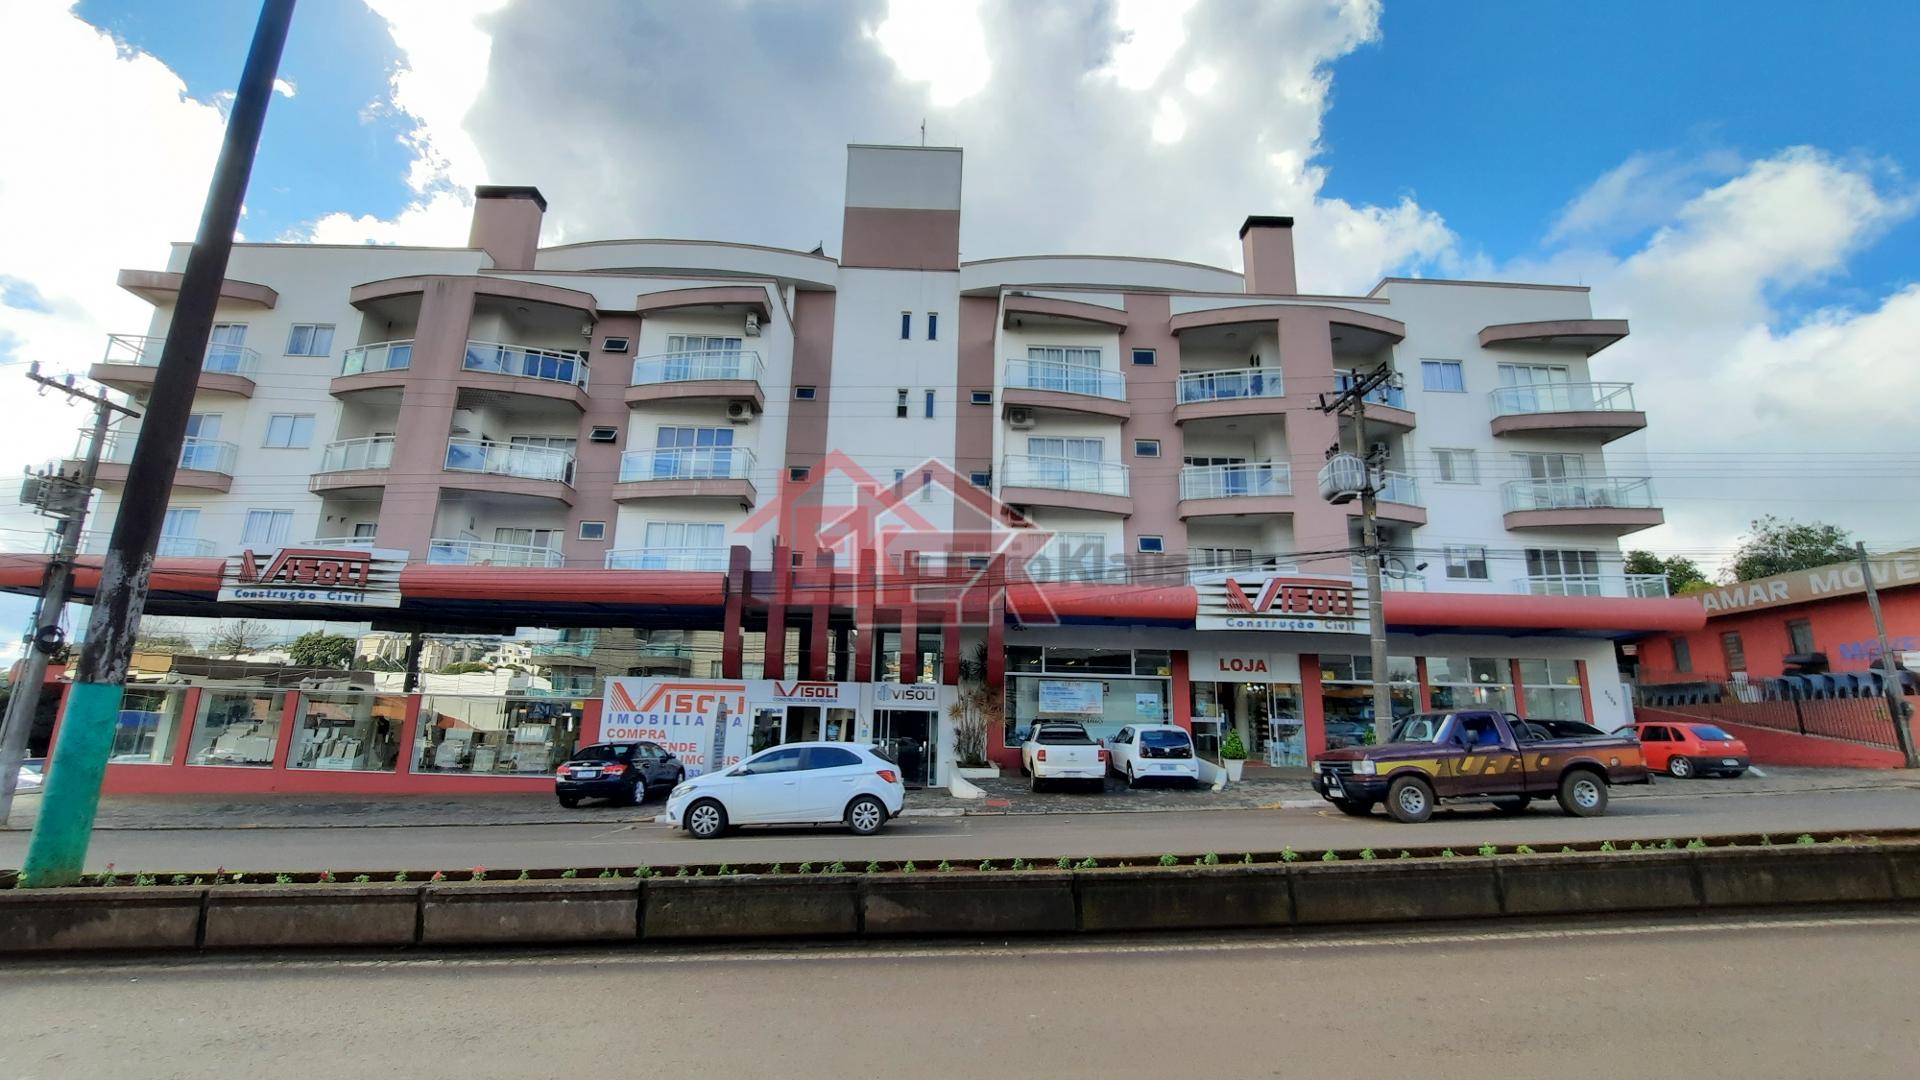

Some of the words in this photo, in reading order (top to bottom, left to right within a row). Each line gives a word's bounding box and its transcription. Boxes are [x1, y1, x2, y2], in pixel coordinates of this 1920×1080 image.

[237, 548, 371, 588] VISOLI
[326, 591, 365, 603] Civil
[1225, 577, 1354, 616] VISOLI
[1324, 620, 1356, 632] Civil
[1219, 658, 1268, 673] LOJA
[773, 681, 839, 698] VISOLI
[892, 689, 936, 701] VISOLI
[607, 713, 743, 727] IMOBILIAA
[607, 728, 667, 740] COMPRA
[657, 742, 697, 753] ENDE
